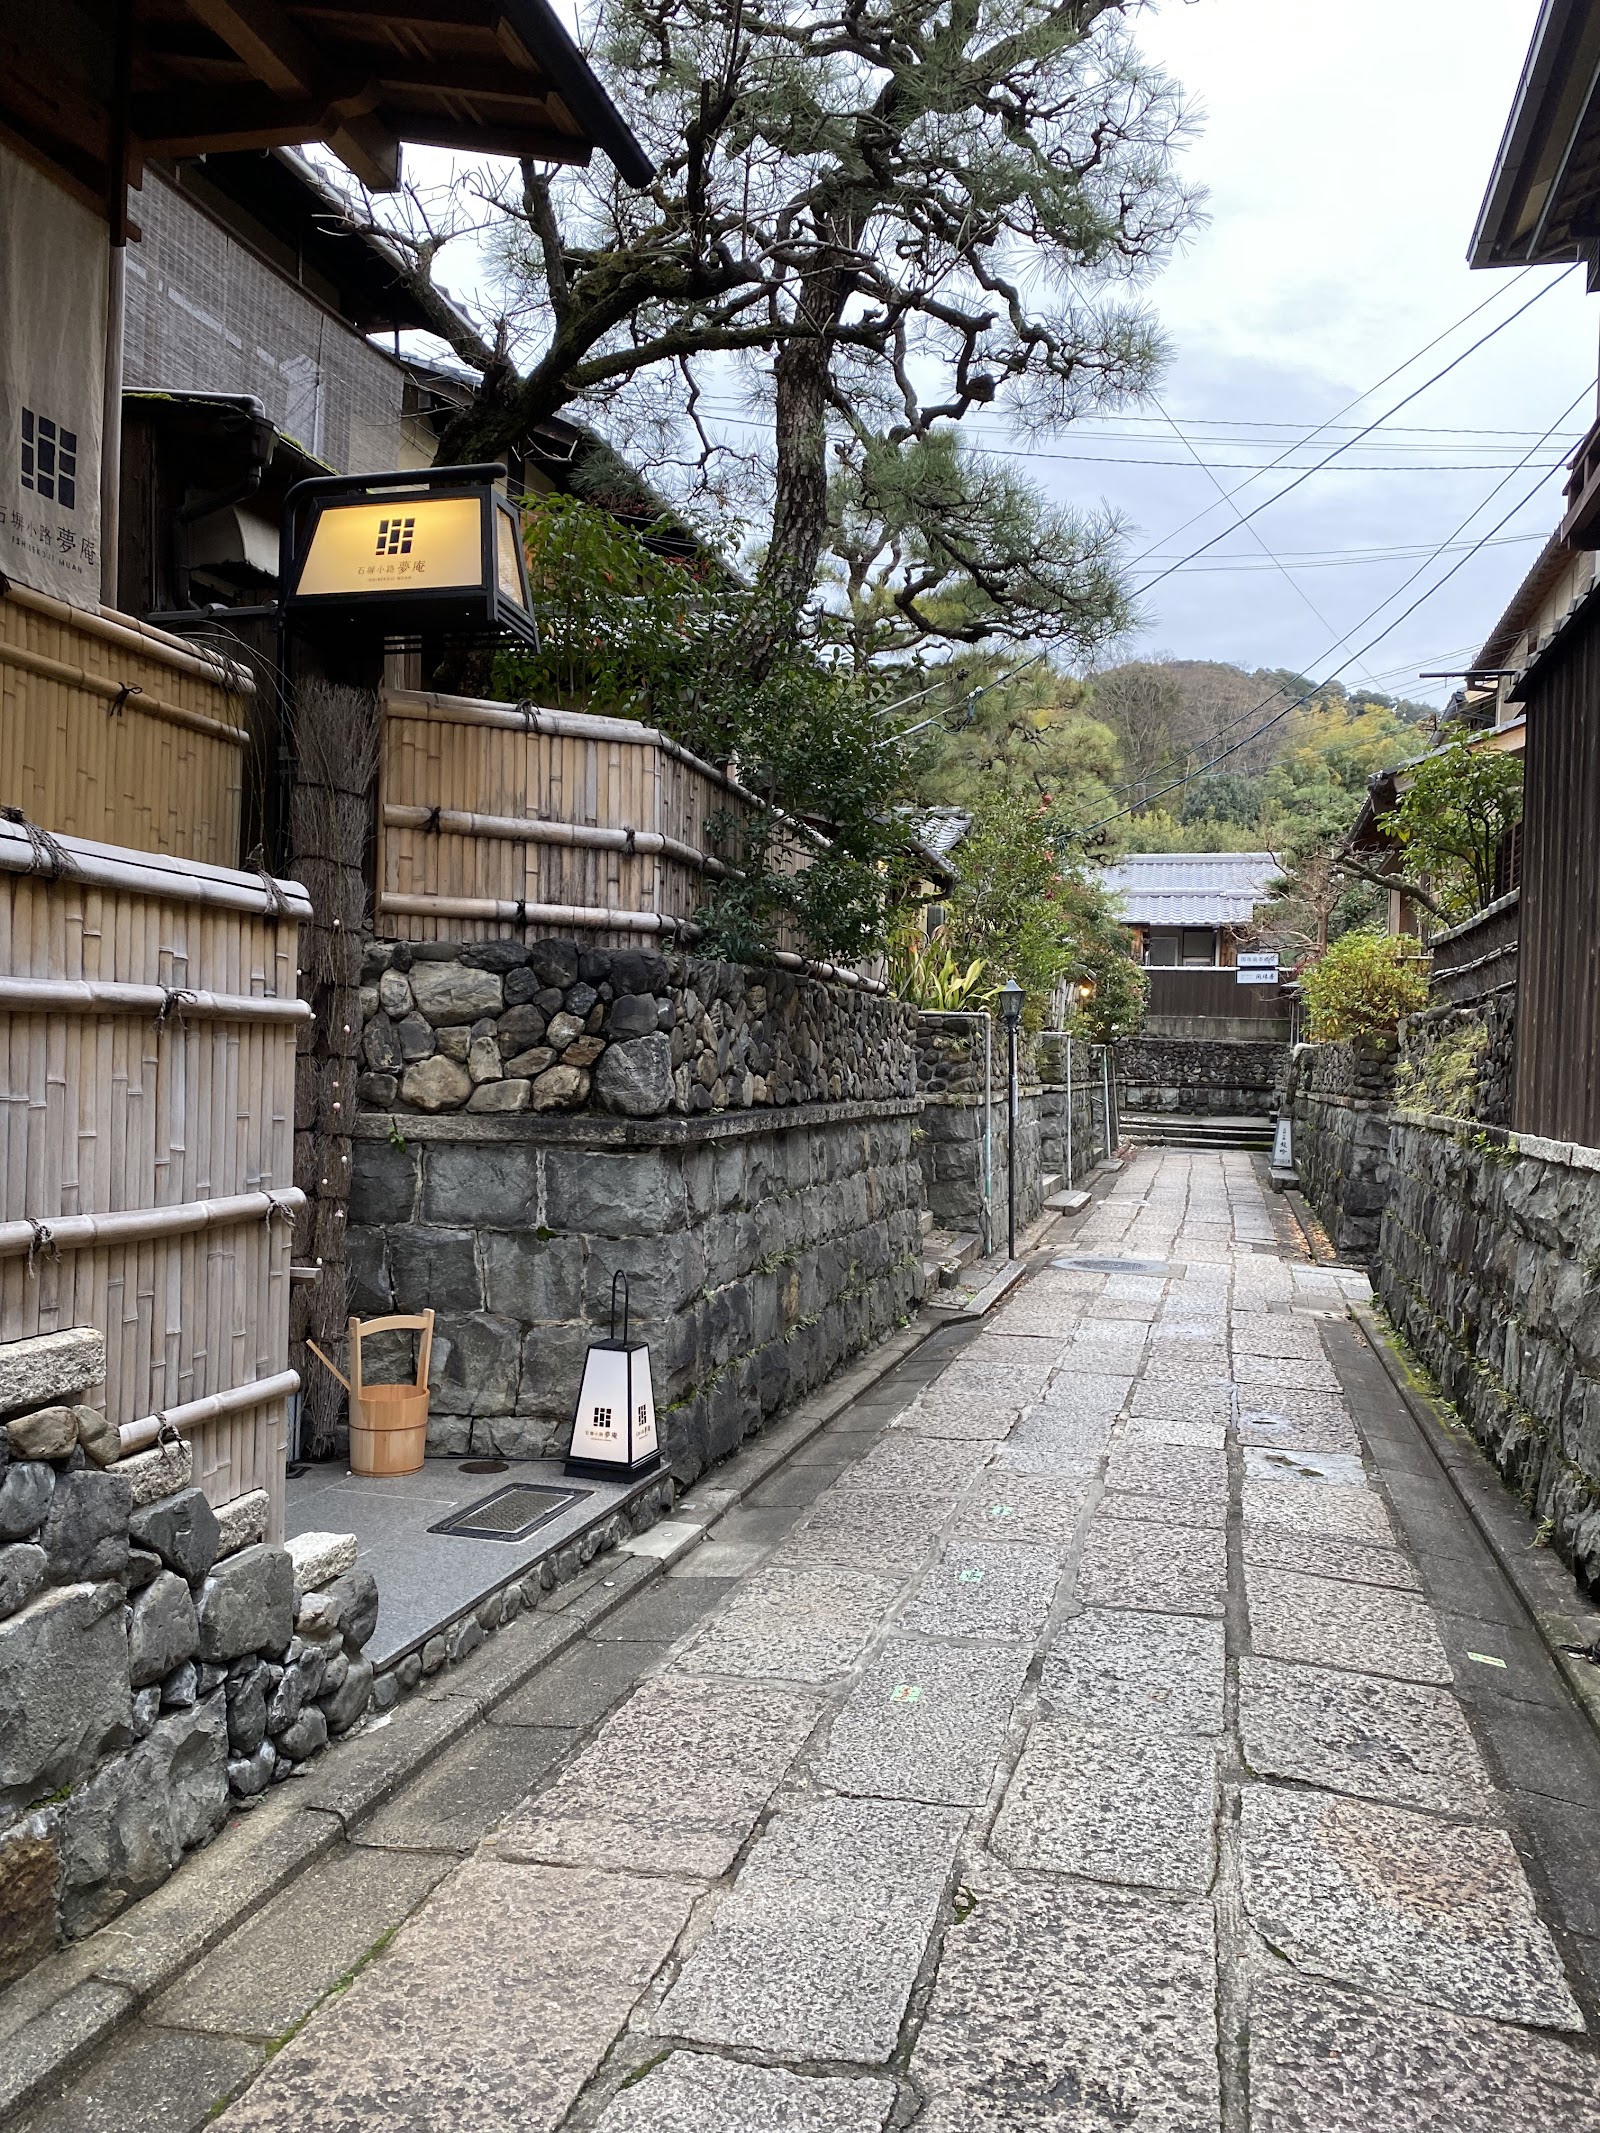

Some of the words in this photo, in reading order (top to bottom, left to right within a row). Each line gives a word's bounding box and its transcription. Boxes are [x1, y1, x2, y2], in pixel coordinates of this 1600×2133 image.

[58, 559, 83, 574] MUAN
[356, 559, 426, 575] 石塀小路夢庵
